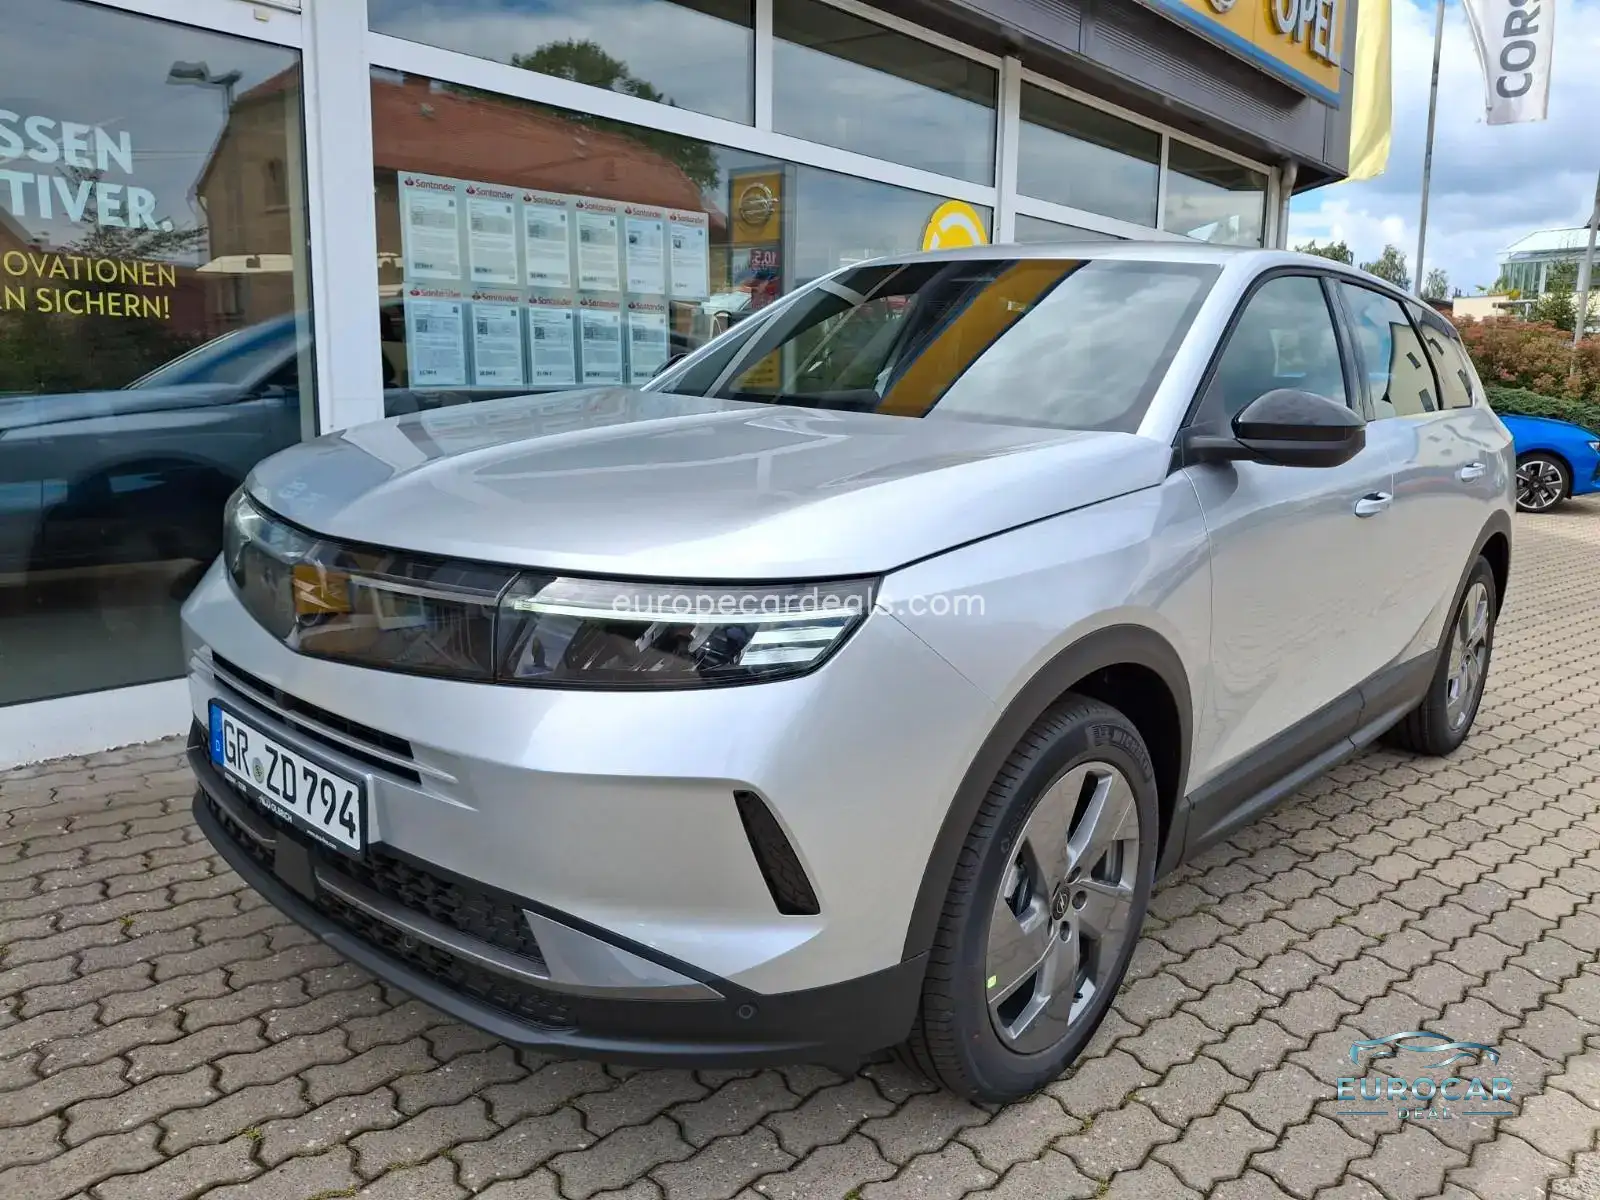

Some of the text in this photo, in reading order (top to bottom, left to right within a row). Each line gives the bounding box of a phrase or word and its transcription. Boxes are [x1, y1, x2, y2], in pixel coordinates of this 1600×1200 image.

[1273, 0, 1340, 66] OPEL
[1496, 0, 1541, 98] COR
[0, 109, 133, 174] SSEN
[0, 169, 174, 233] TIVER.
[3, 250, 176, 288] OVATIONEN
[36, 288, 170, 319] SICHERN!
[224, 719, 250, 776] GR
[265, 743, 297, 805] ZD
[303, 766, 356, 839] 794
